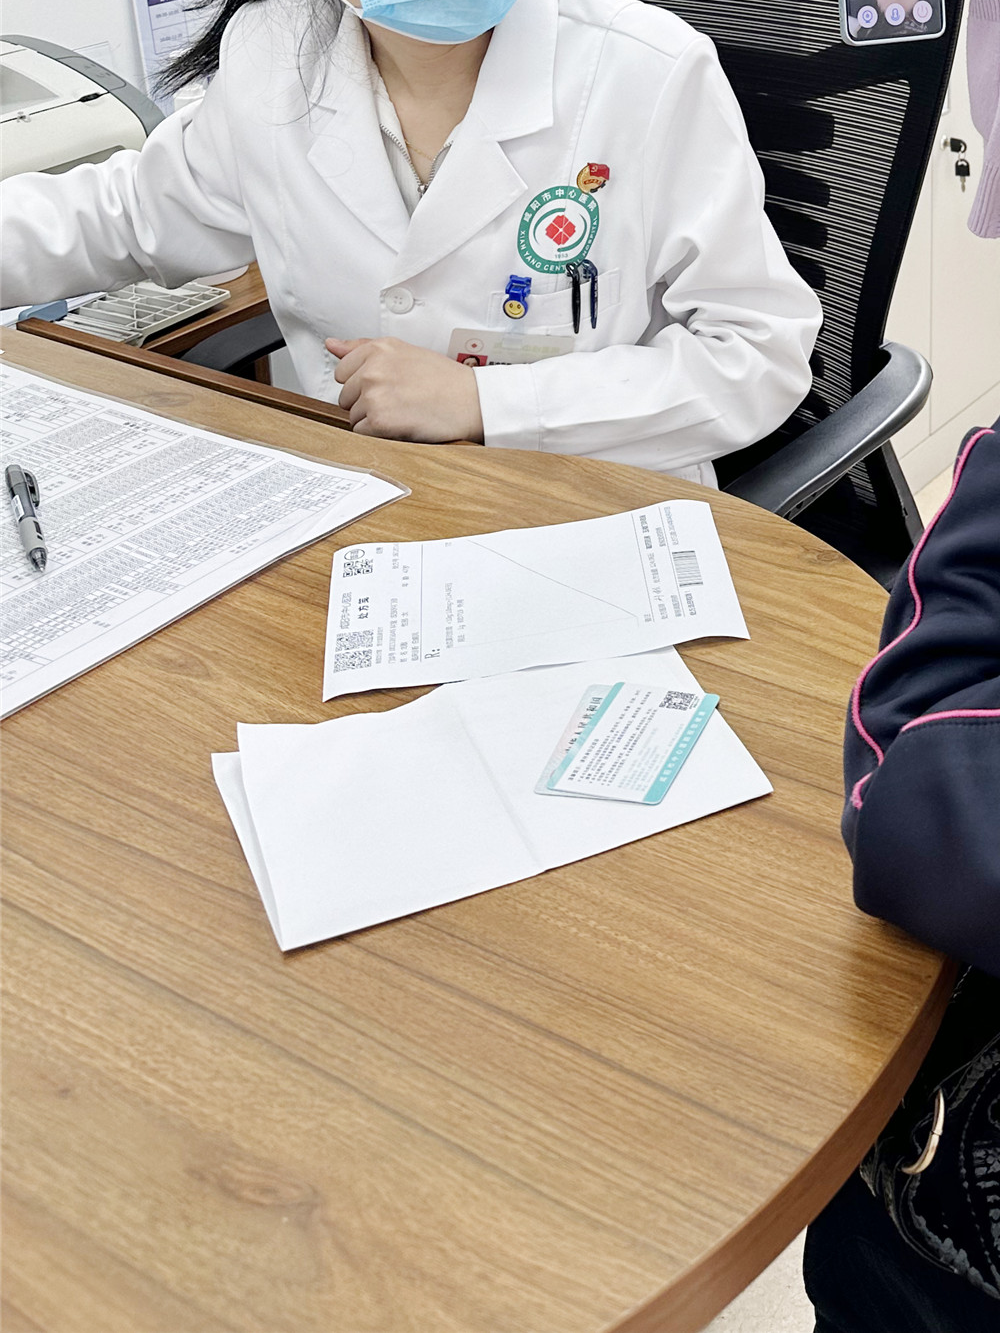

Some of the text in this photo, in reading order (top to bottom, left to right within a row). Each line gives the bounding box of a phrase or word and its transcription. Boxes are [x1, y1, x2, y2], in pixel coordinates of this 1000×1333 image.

[523, 188, 598, 223] 咸阳市中心医院
[519, 230, 527, 251] XIAN
[523, 251, 542, 269] YANG
